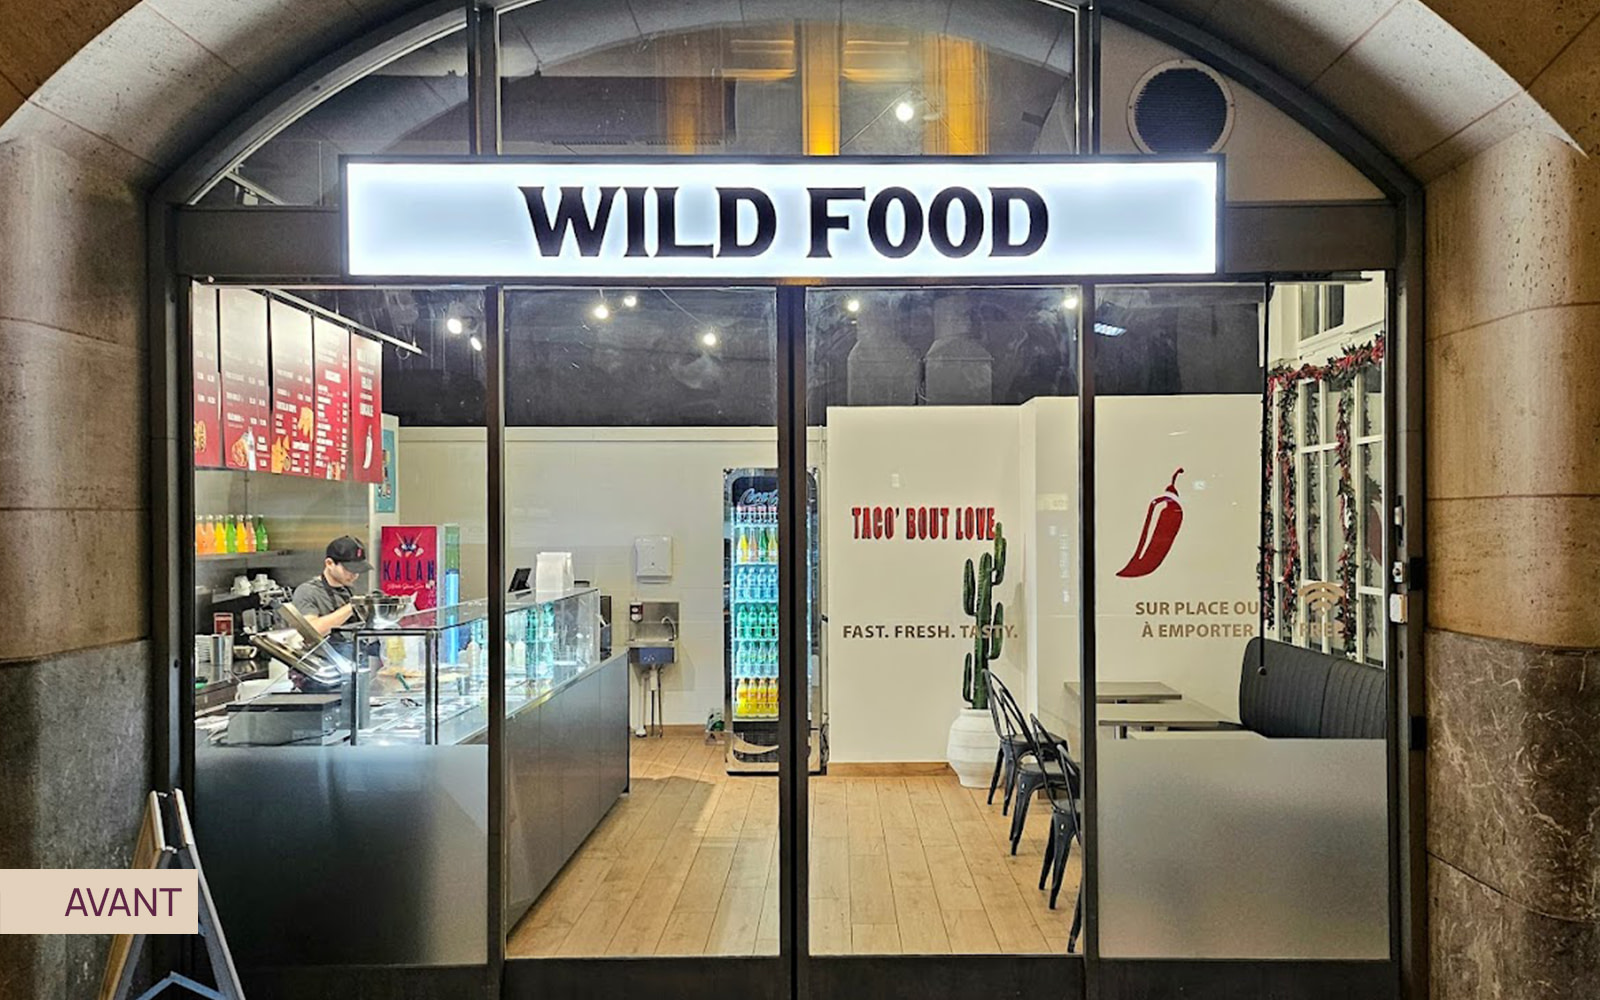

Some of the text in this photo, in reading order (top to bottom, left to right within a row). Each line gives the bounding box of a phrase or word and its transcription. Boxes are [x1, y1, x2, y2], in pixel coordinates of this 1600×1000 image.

[518, 186, 1049, 258] WILD FOOD
[851, 506, 995, 540] TACO' BOUT LOVE
[1135, 601, 1259, 615] SUR PLACE OU
[843, 625, 889, 638] FAST.
[895, 625, 955, 638] FRESH.
[1142, 620, 1254, 638] À EMPORTER
